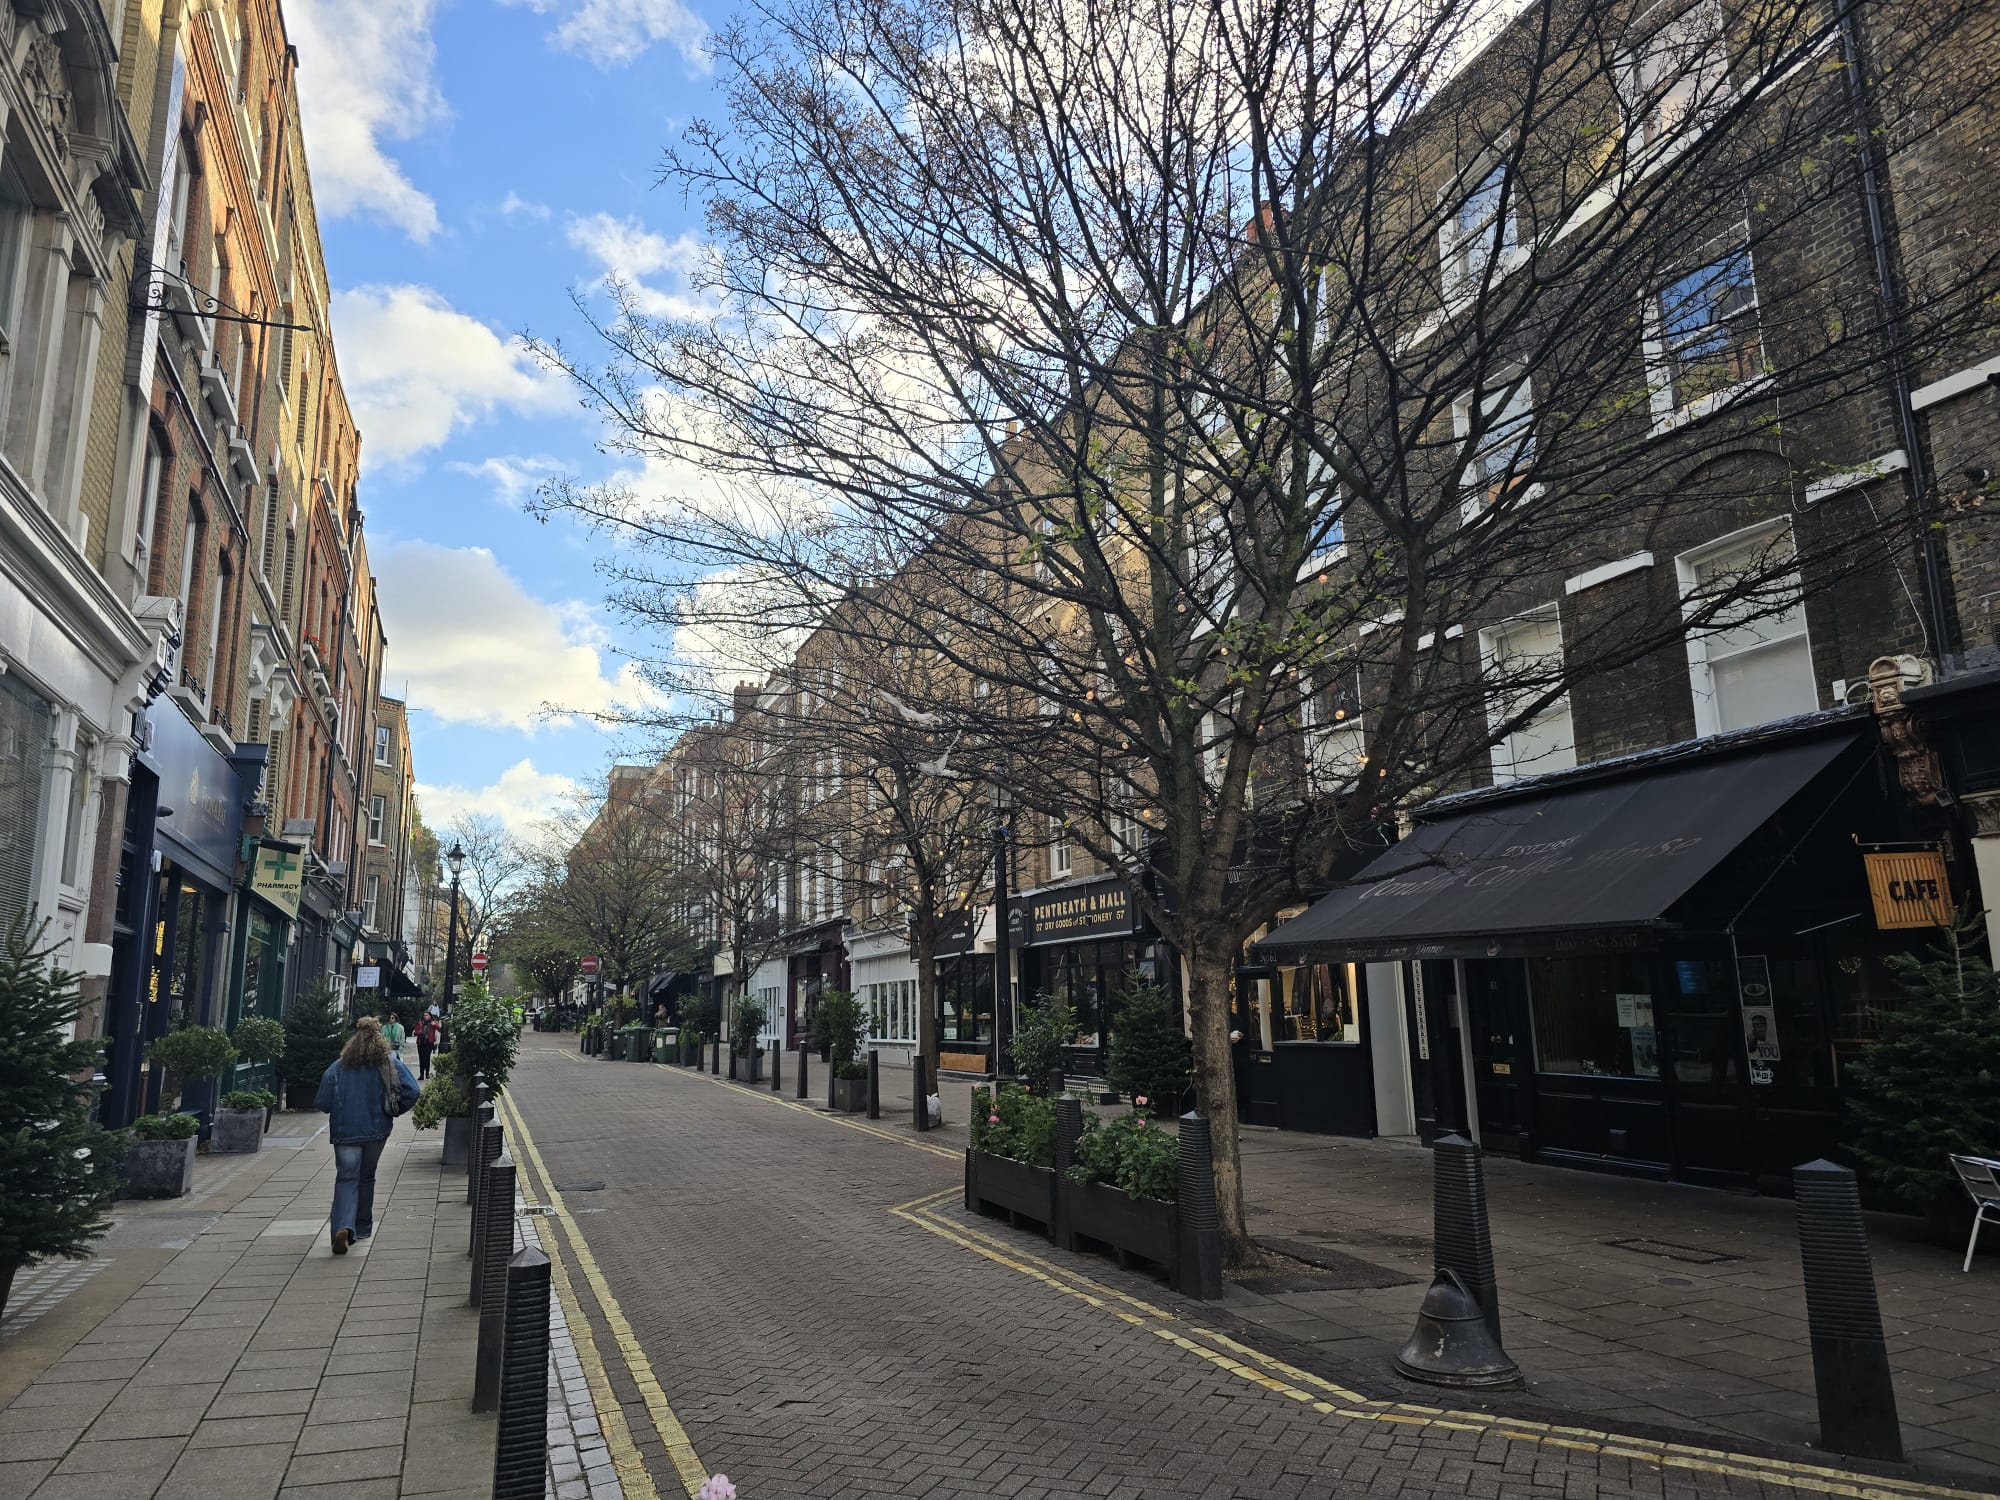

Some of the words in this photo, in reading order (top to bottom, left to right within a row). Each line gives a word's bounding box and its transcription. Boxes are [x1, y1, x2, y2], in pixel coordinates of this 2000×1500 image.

[1464, 853, 1574, 890] Coffee
[256, 882, 299, 890] PHARMACY
[1888, 879, 1939, 902] CAFE
[1034, 897, 1087, 920] PENTREATH
[1090, 895, 1097, 910] &
[1099, 890, 1126, 908] HALL
[1036, 923, 1043, 932] 57
[1044, 921, 1055, 931] DRY
[1055, 918, 1073, 929] GOODS
[1079, 911, 1113, 925] STIONERY
[1116, 910, 1125, 920] 57
[1757, 1047, 1779, 1058] YOU
